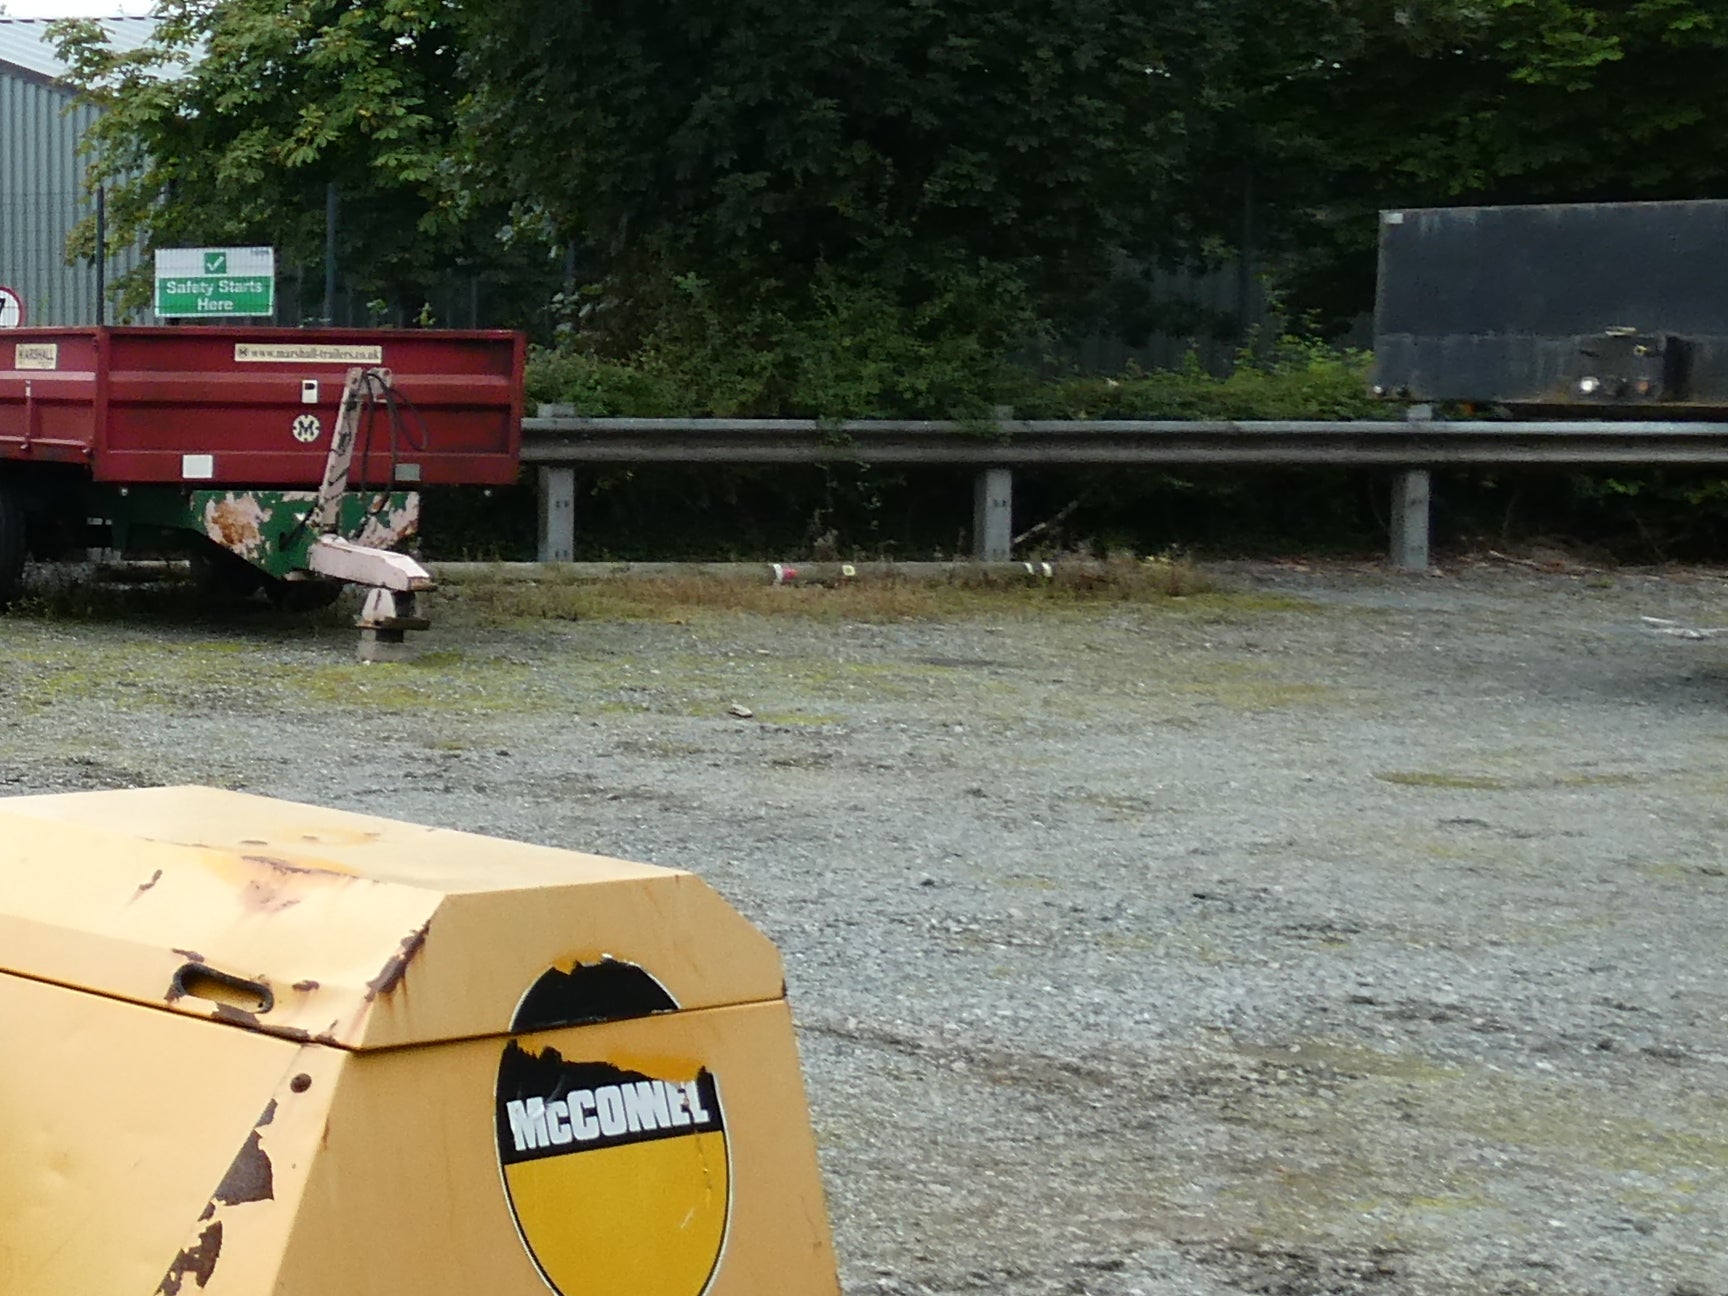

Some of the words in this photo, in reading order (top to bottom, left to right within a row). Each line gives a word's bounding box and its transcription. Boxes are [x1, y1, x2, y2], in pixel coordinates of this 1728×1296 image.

[166, 280, 214, 296] Safety
[218, 279, 263, 293] Starts
[197, 298, 234, 311] Here
[251, 347, 380, 360] www.marshall-trailers.co.uk
